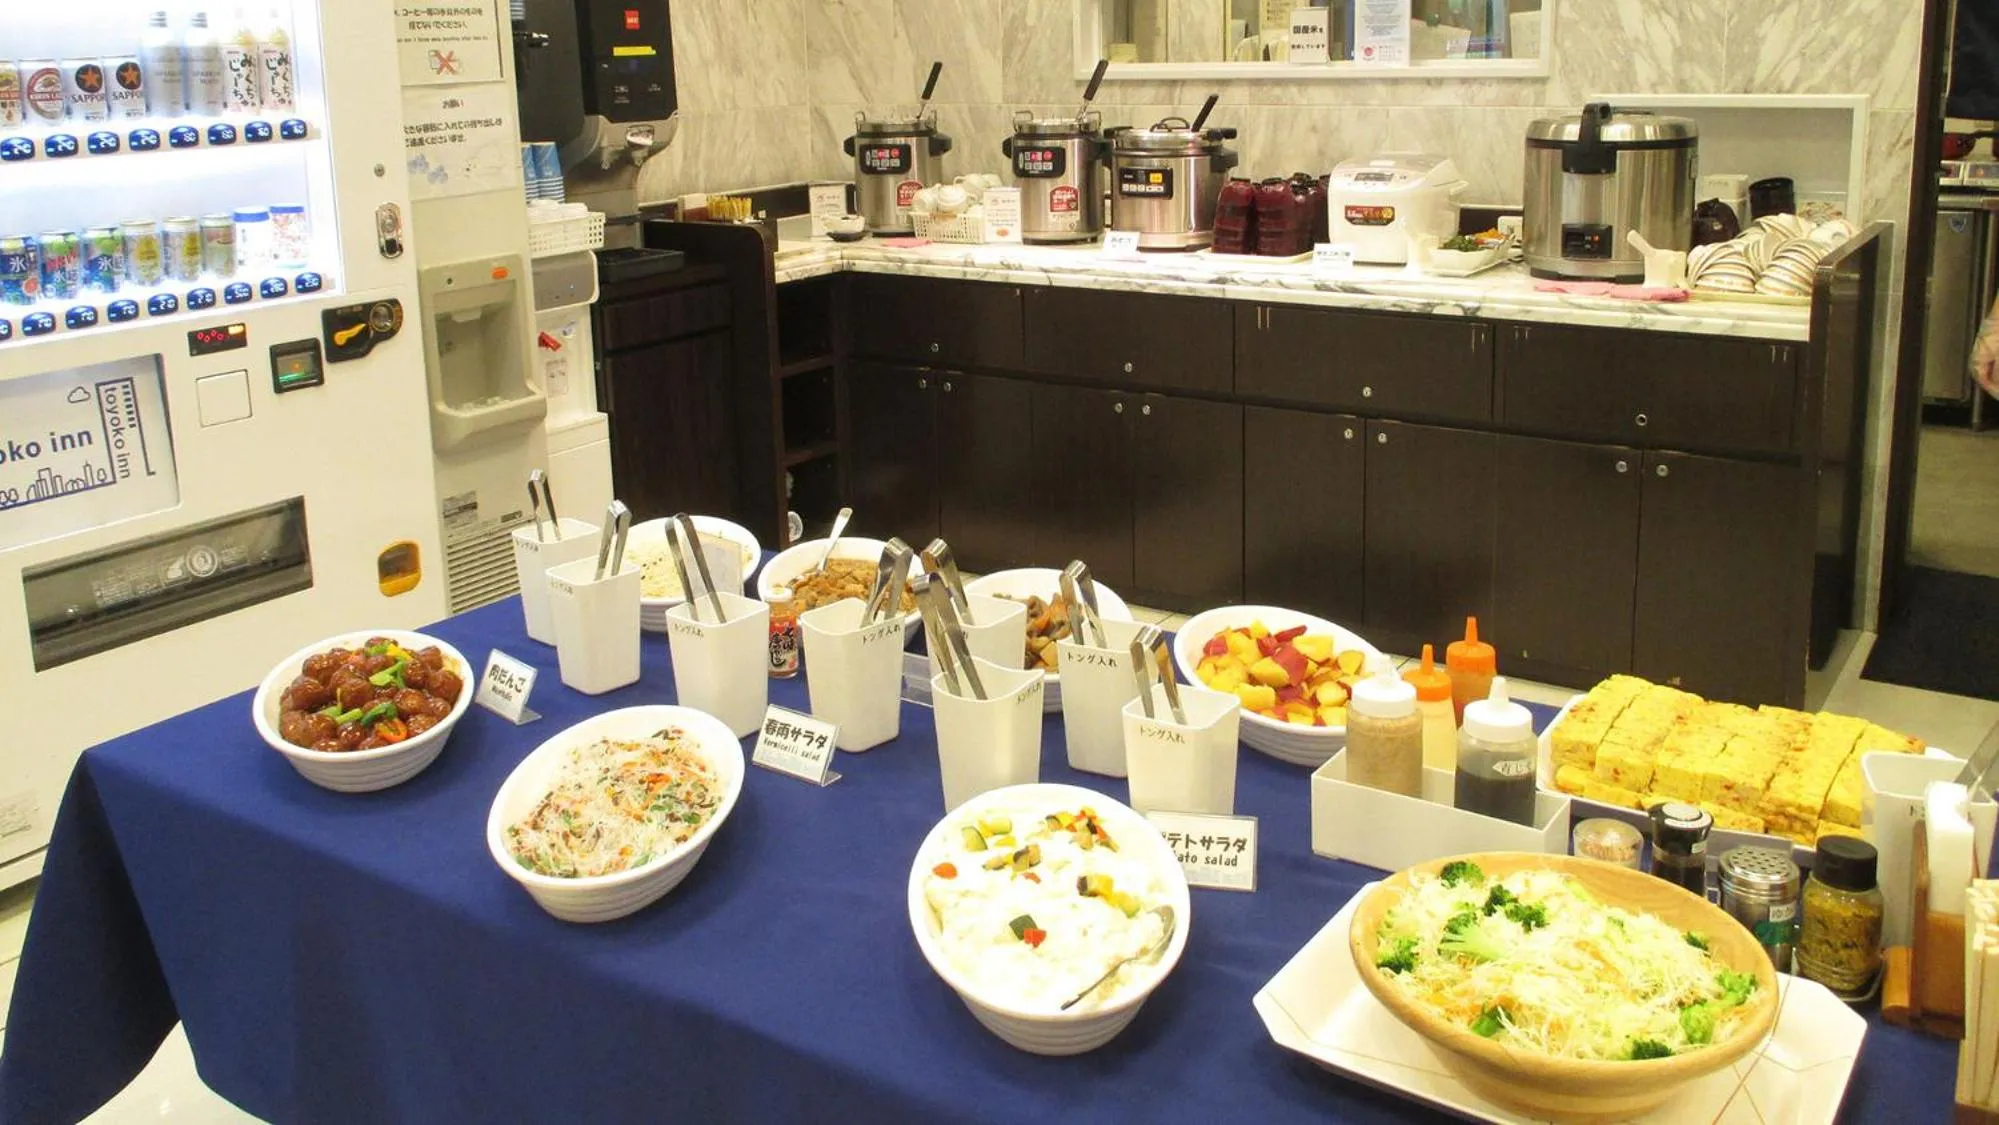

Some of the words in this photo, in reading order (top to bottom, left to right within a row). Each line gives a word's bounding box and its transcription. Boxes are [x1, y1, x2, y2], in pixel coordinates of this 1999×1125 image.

[50, 430, 93, 452] inn
[104, 387, 126, 449] toyoko
[116, 452, 131, 479] inn
[1066, 652, 1118, 669] トング入れ
[764, 718, 828, 749] 春雨サラダ
[1139, 725, 1185, 745] トング入れ
[1204, 853, 1238, 867] salad
